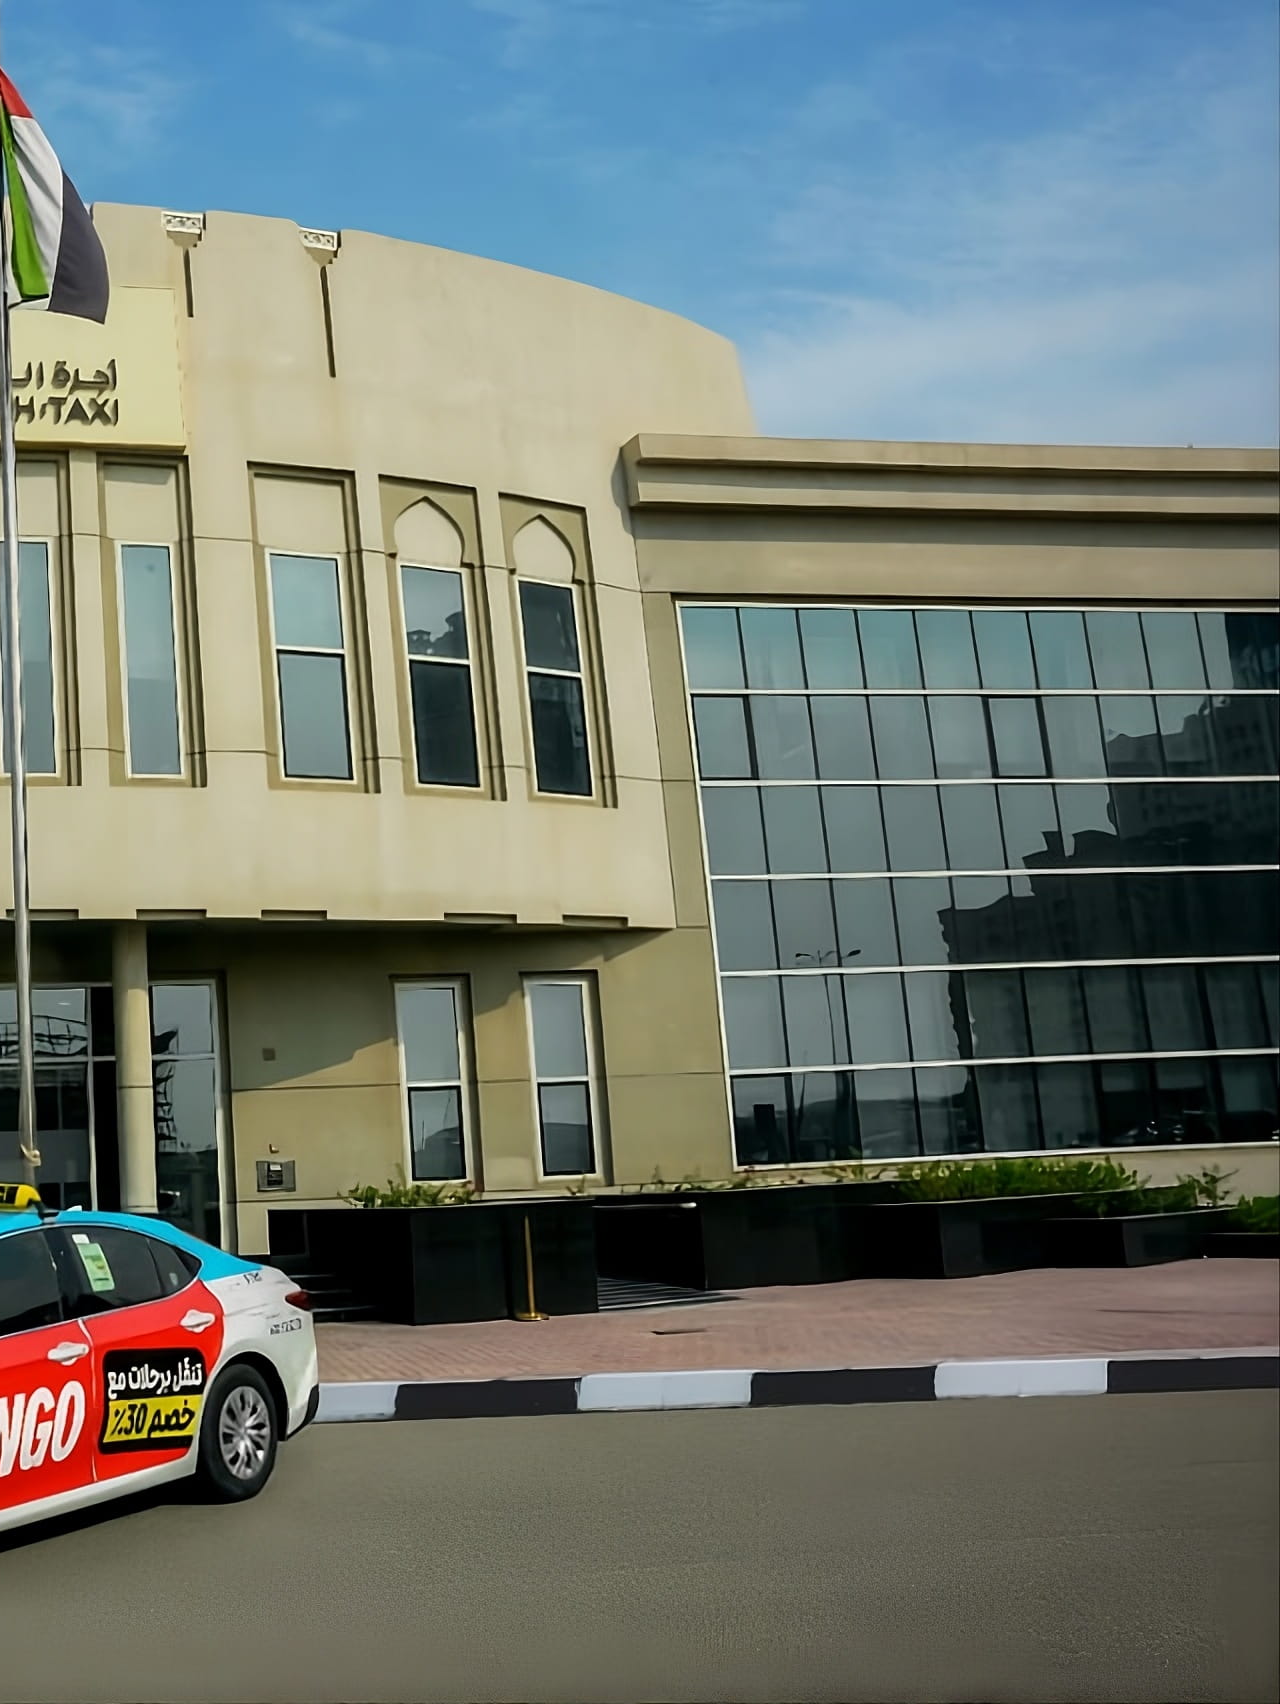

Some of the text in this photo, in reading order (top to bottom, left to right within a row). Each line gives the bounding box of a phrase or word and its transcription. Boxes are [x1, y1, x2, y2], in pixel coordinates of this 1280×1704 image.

[48, 397, 119, 426] TAXI
[107, 1371, 126, 1400] مع
[147, 1399, 196, 1439] خصم
